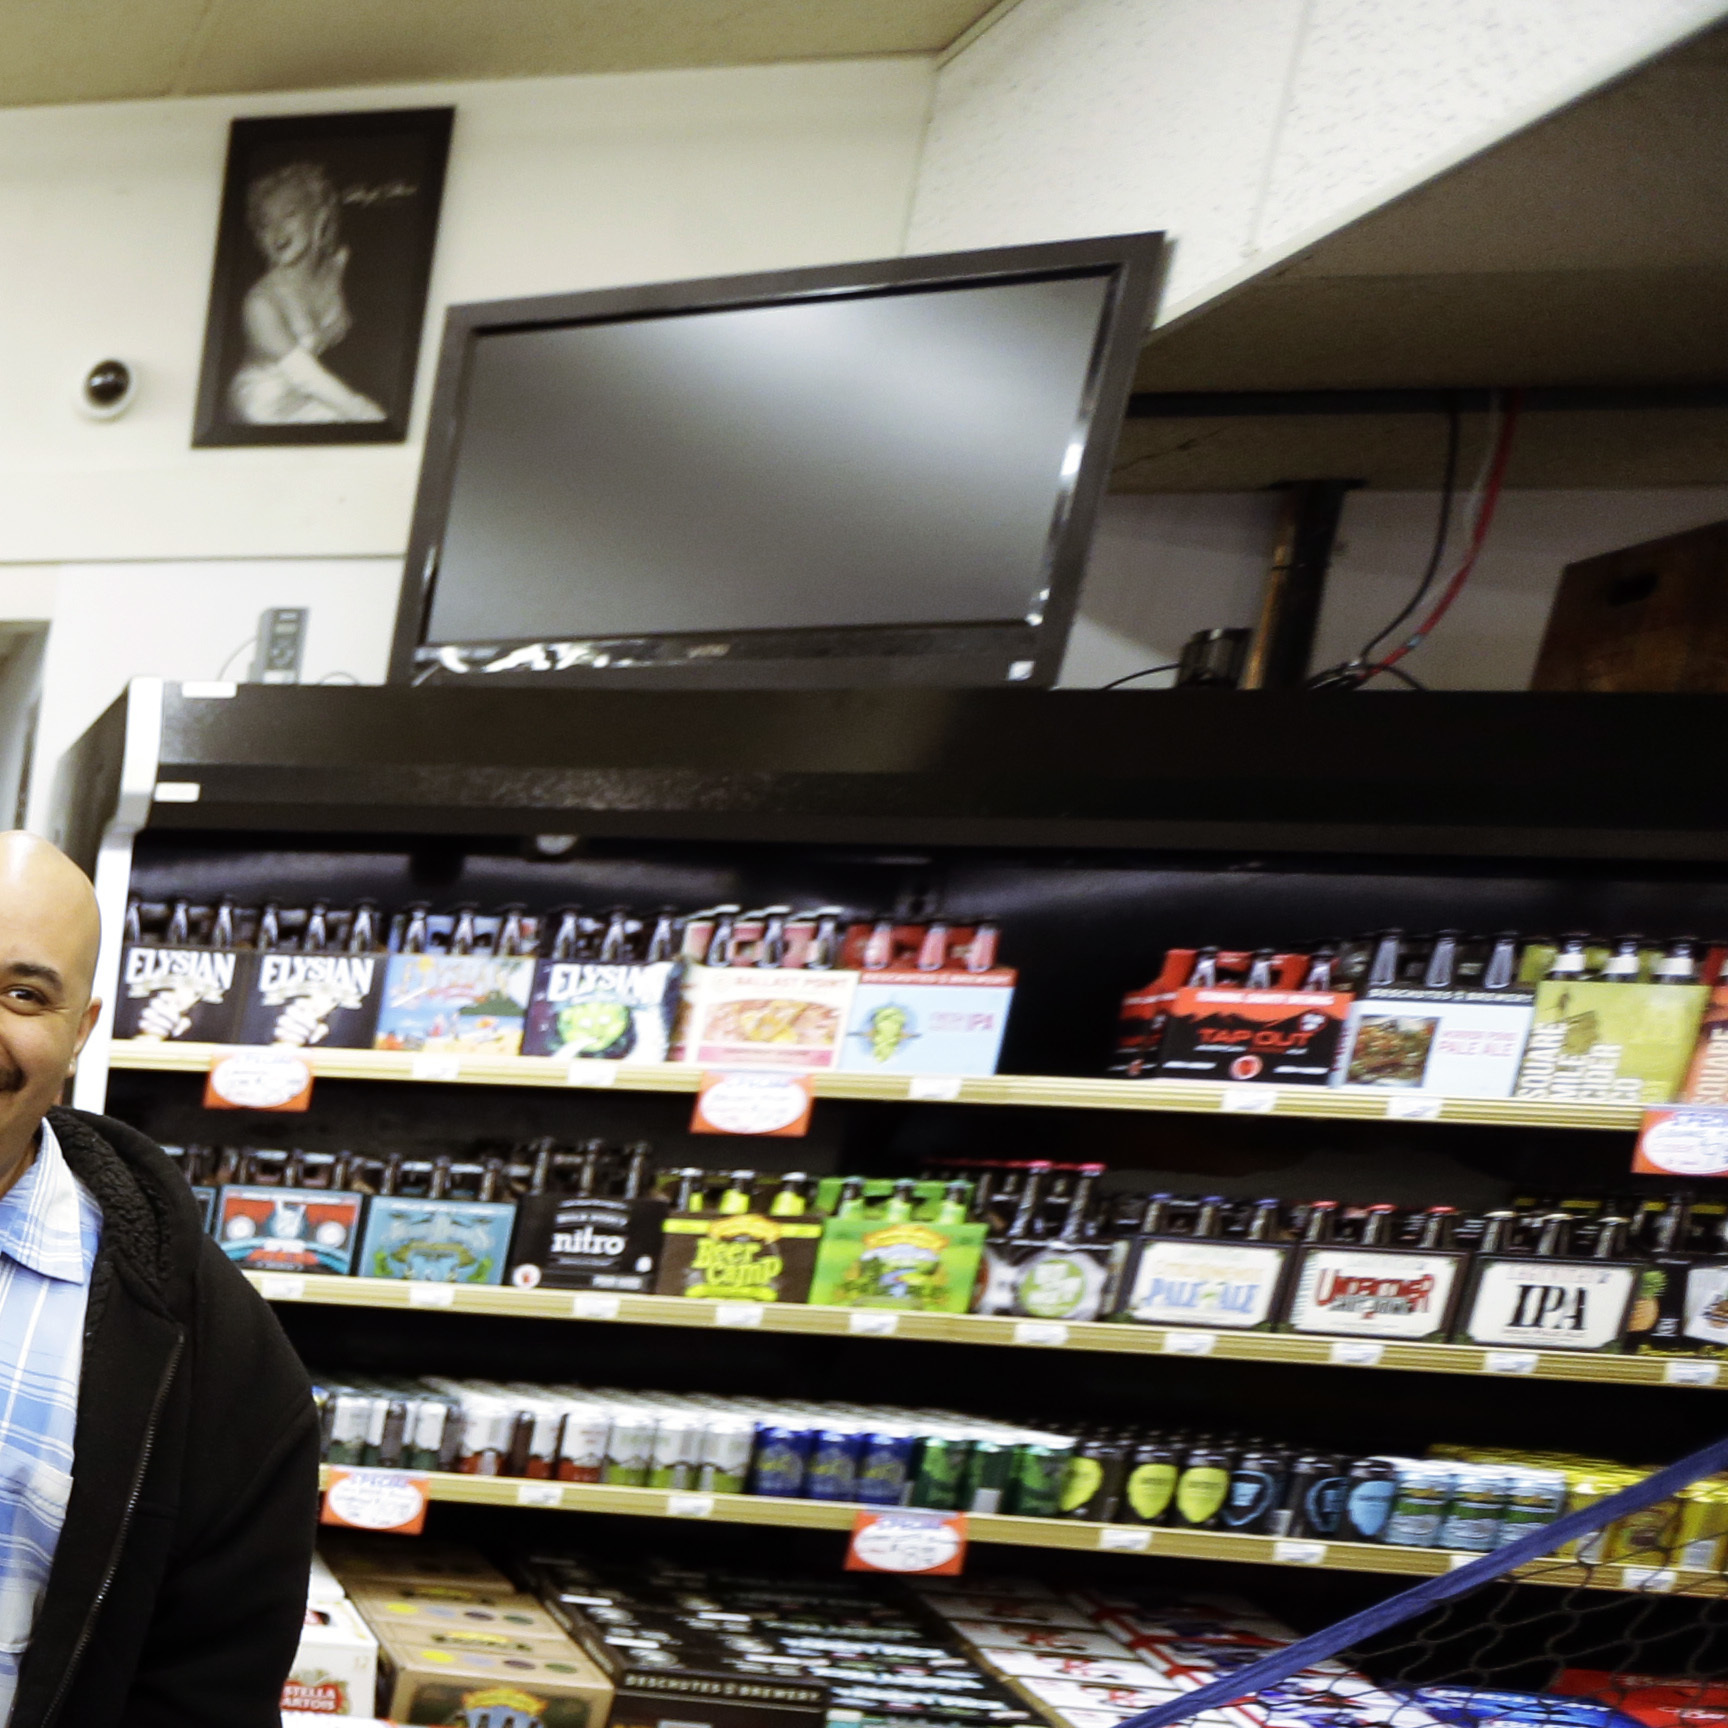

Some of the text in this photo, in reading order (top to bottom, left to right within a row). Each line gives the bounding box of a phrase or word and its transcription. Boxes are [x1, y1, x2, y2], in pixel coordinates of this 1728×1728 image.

[126, 946, 237, 990] ELYSIAN
[260, 954, 375, 995] ELYSIAN
[551, 1227, 626, 1256] nitro
[693, 1238, 760, 1270] Beer
[1145, 1278, 1260, 1313] PALE ALE
[1506, 1283, 1589, 1331] IPA
[282, 1685, 337, 1701] STELLA
[624, 1673, 722, 1696] DESCHUTES
[739, 1685, 822, 1702] BREWERY
